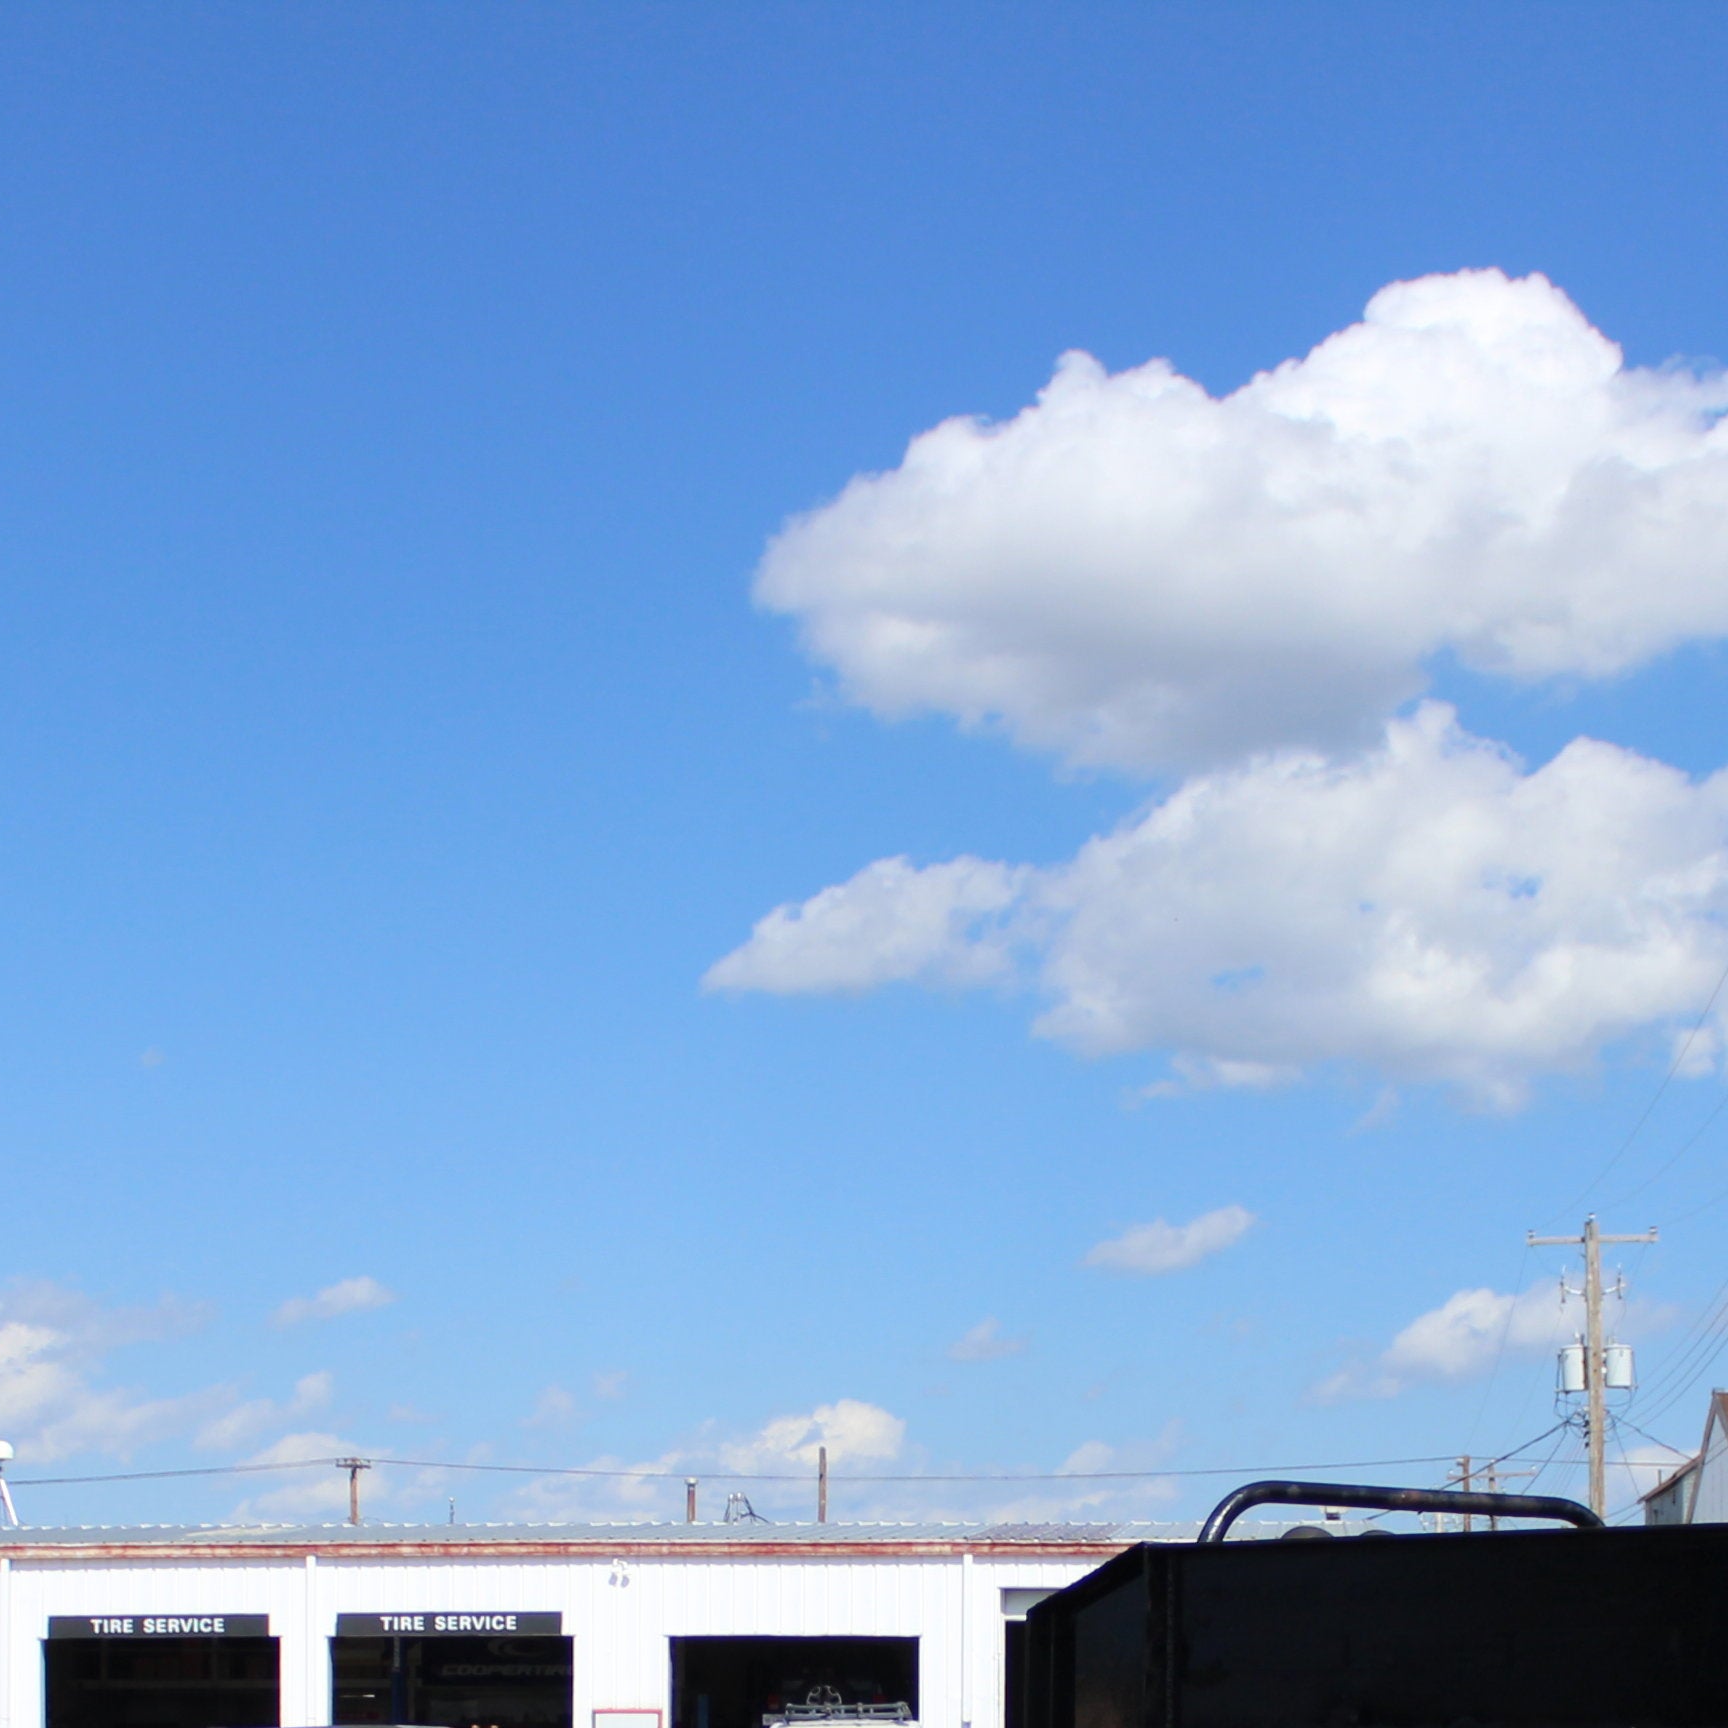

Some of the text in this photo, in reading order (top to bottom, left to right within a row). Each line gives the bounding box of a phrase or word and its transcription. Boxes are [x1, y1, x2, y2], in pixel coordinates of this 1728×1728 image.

[90, 1617, 225, 1634] TIRE SERVICE
[380, 1615, 517, 1632] TIRE SERVICE
[441, 1663, 572, 1676] COOPERTIR
